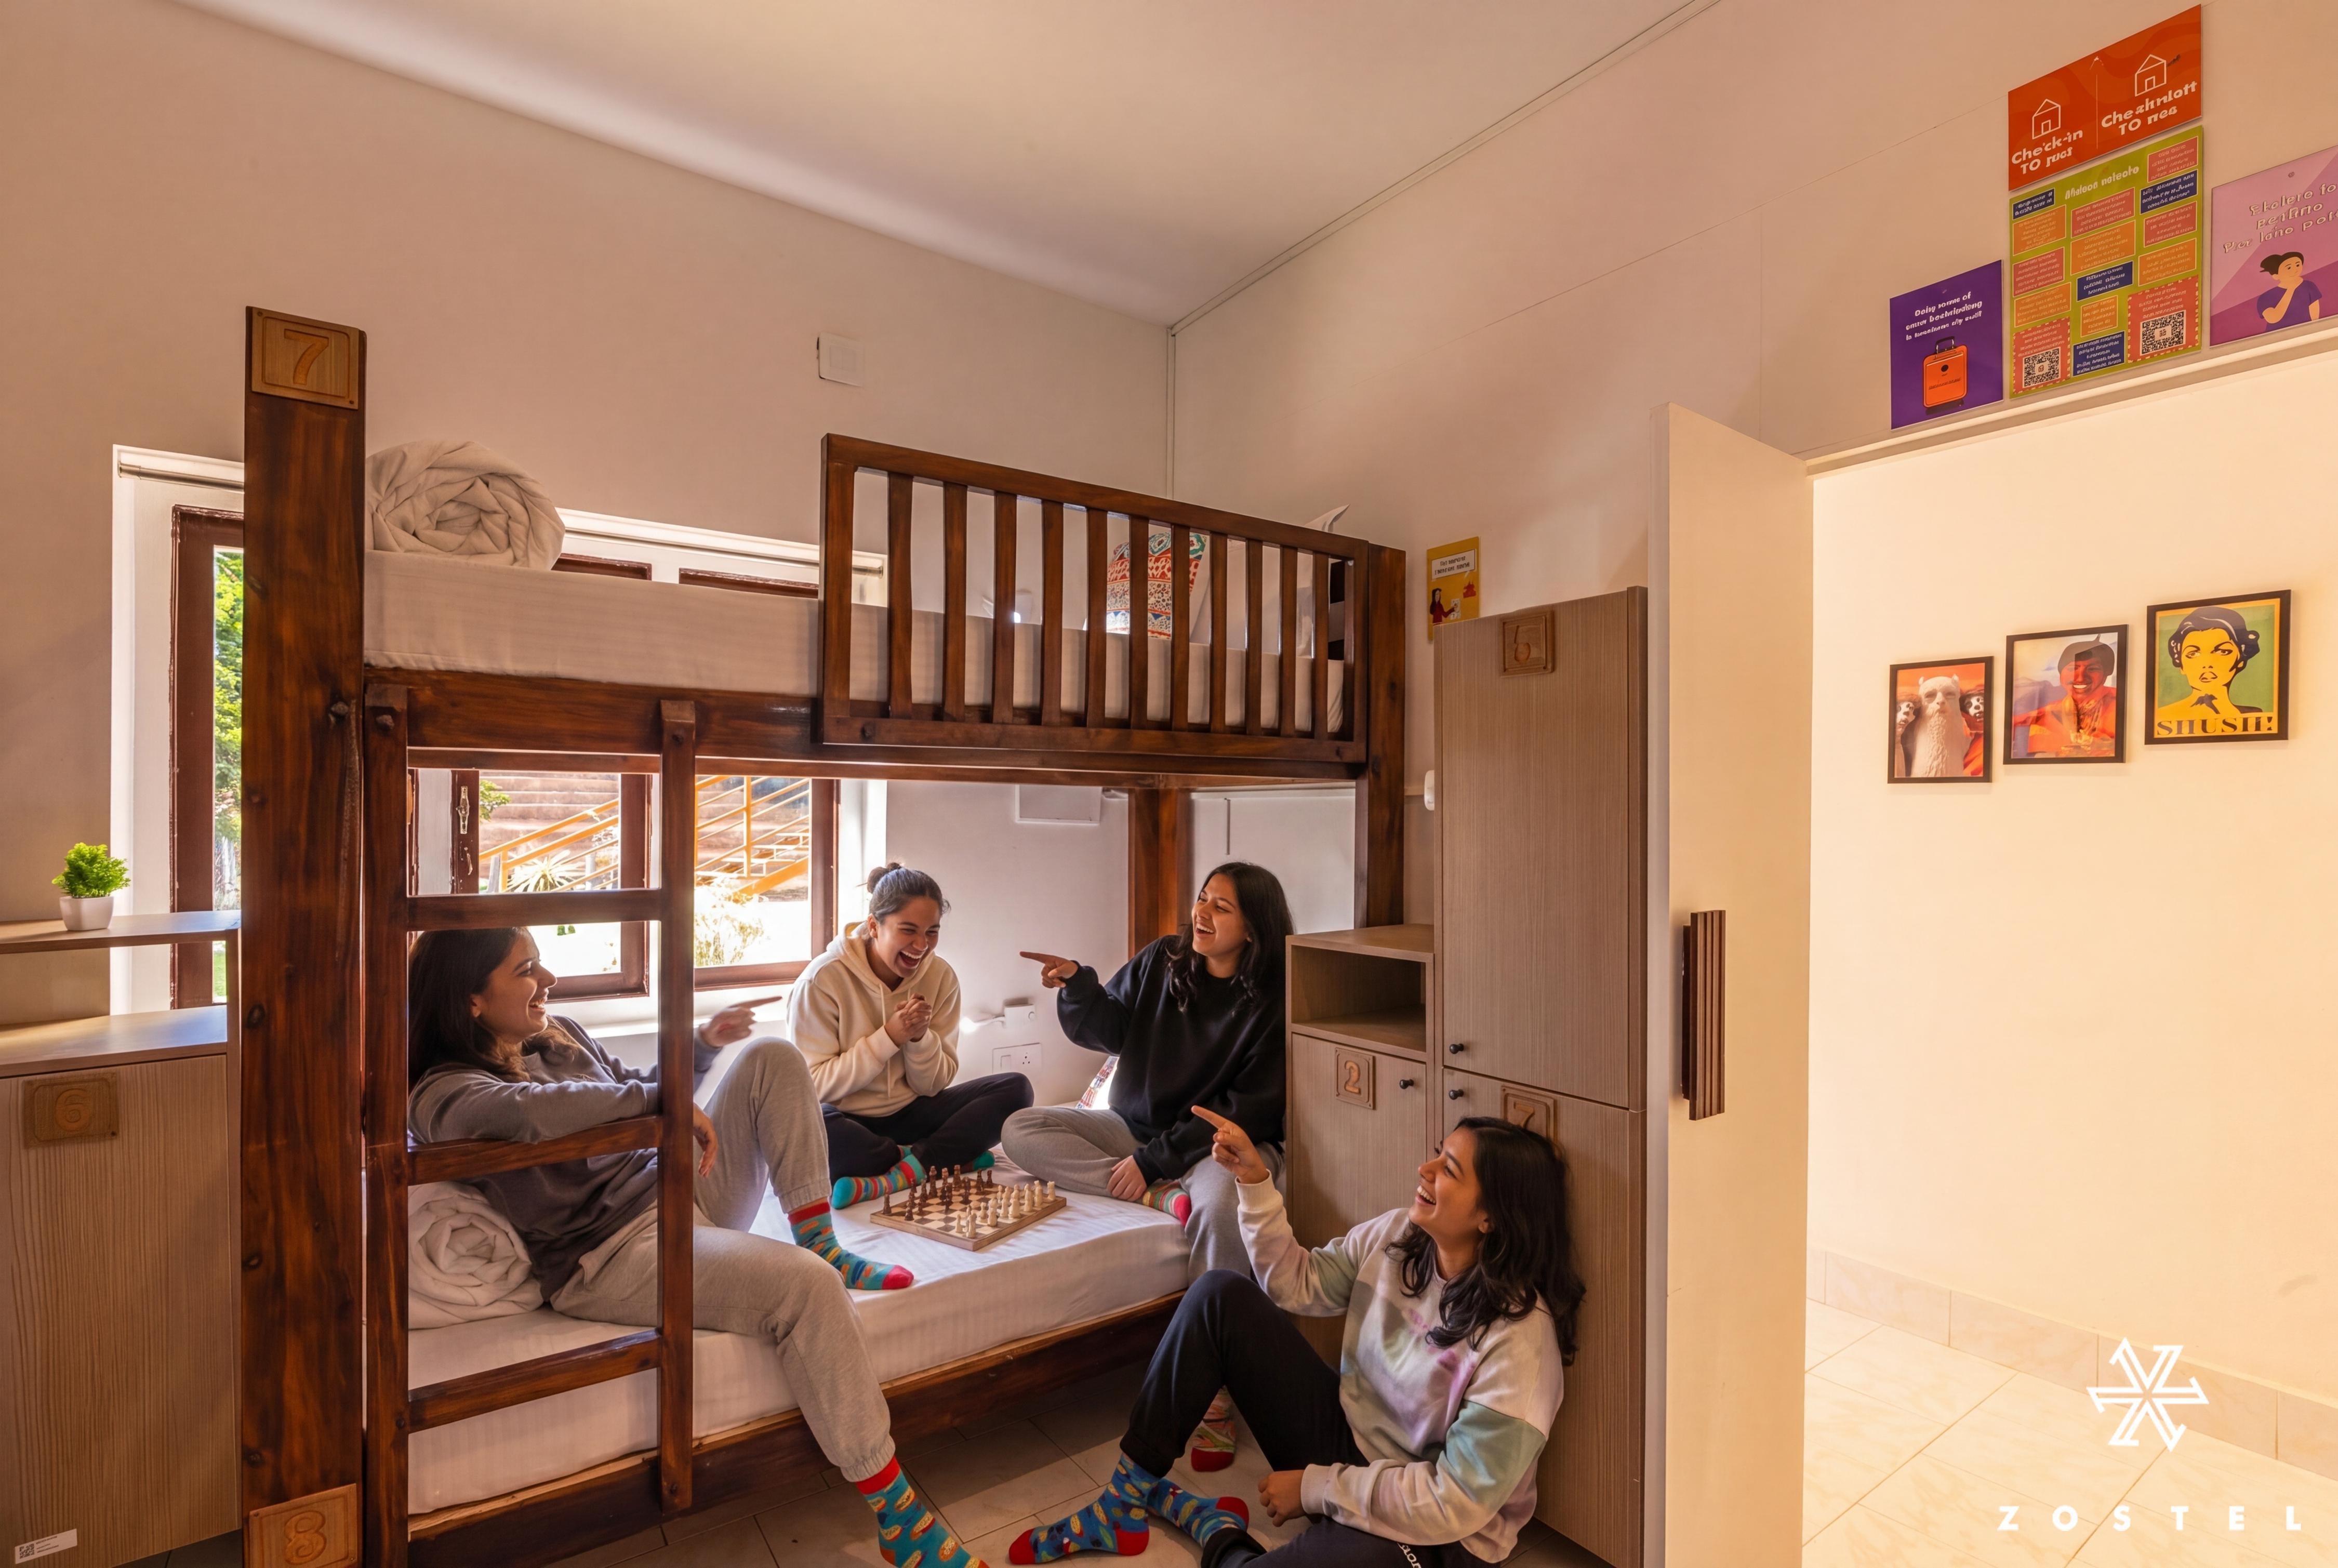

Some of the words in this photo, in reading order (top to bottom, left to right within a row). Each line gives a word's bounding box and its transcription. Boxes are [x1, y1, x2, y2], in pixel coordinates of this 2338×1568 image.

[2011, 130, 2083, 164] Check-in
[284, 328, 329, 386] 7
[1345, 1060, 1361, 1094] 2
[55, 1088, 91, 1132] 6
